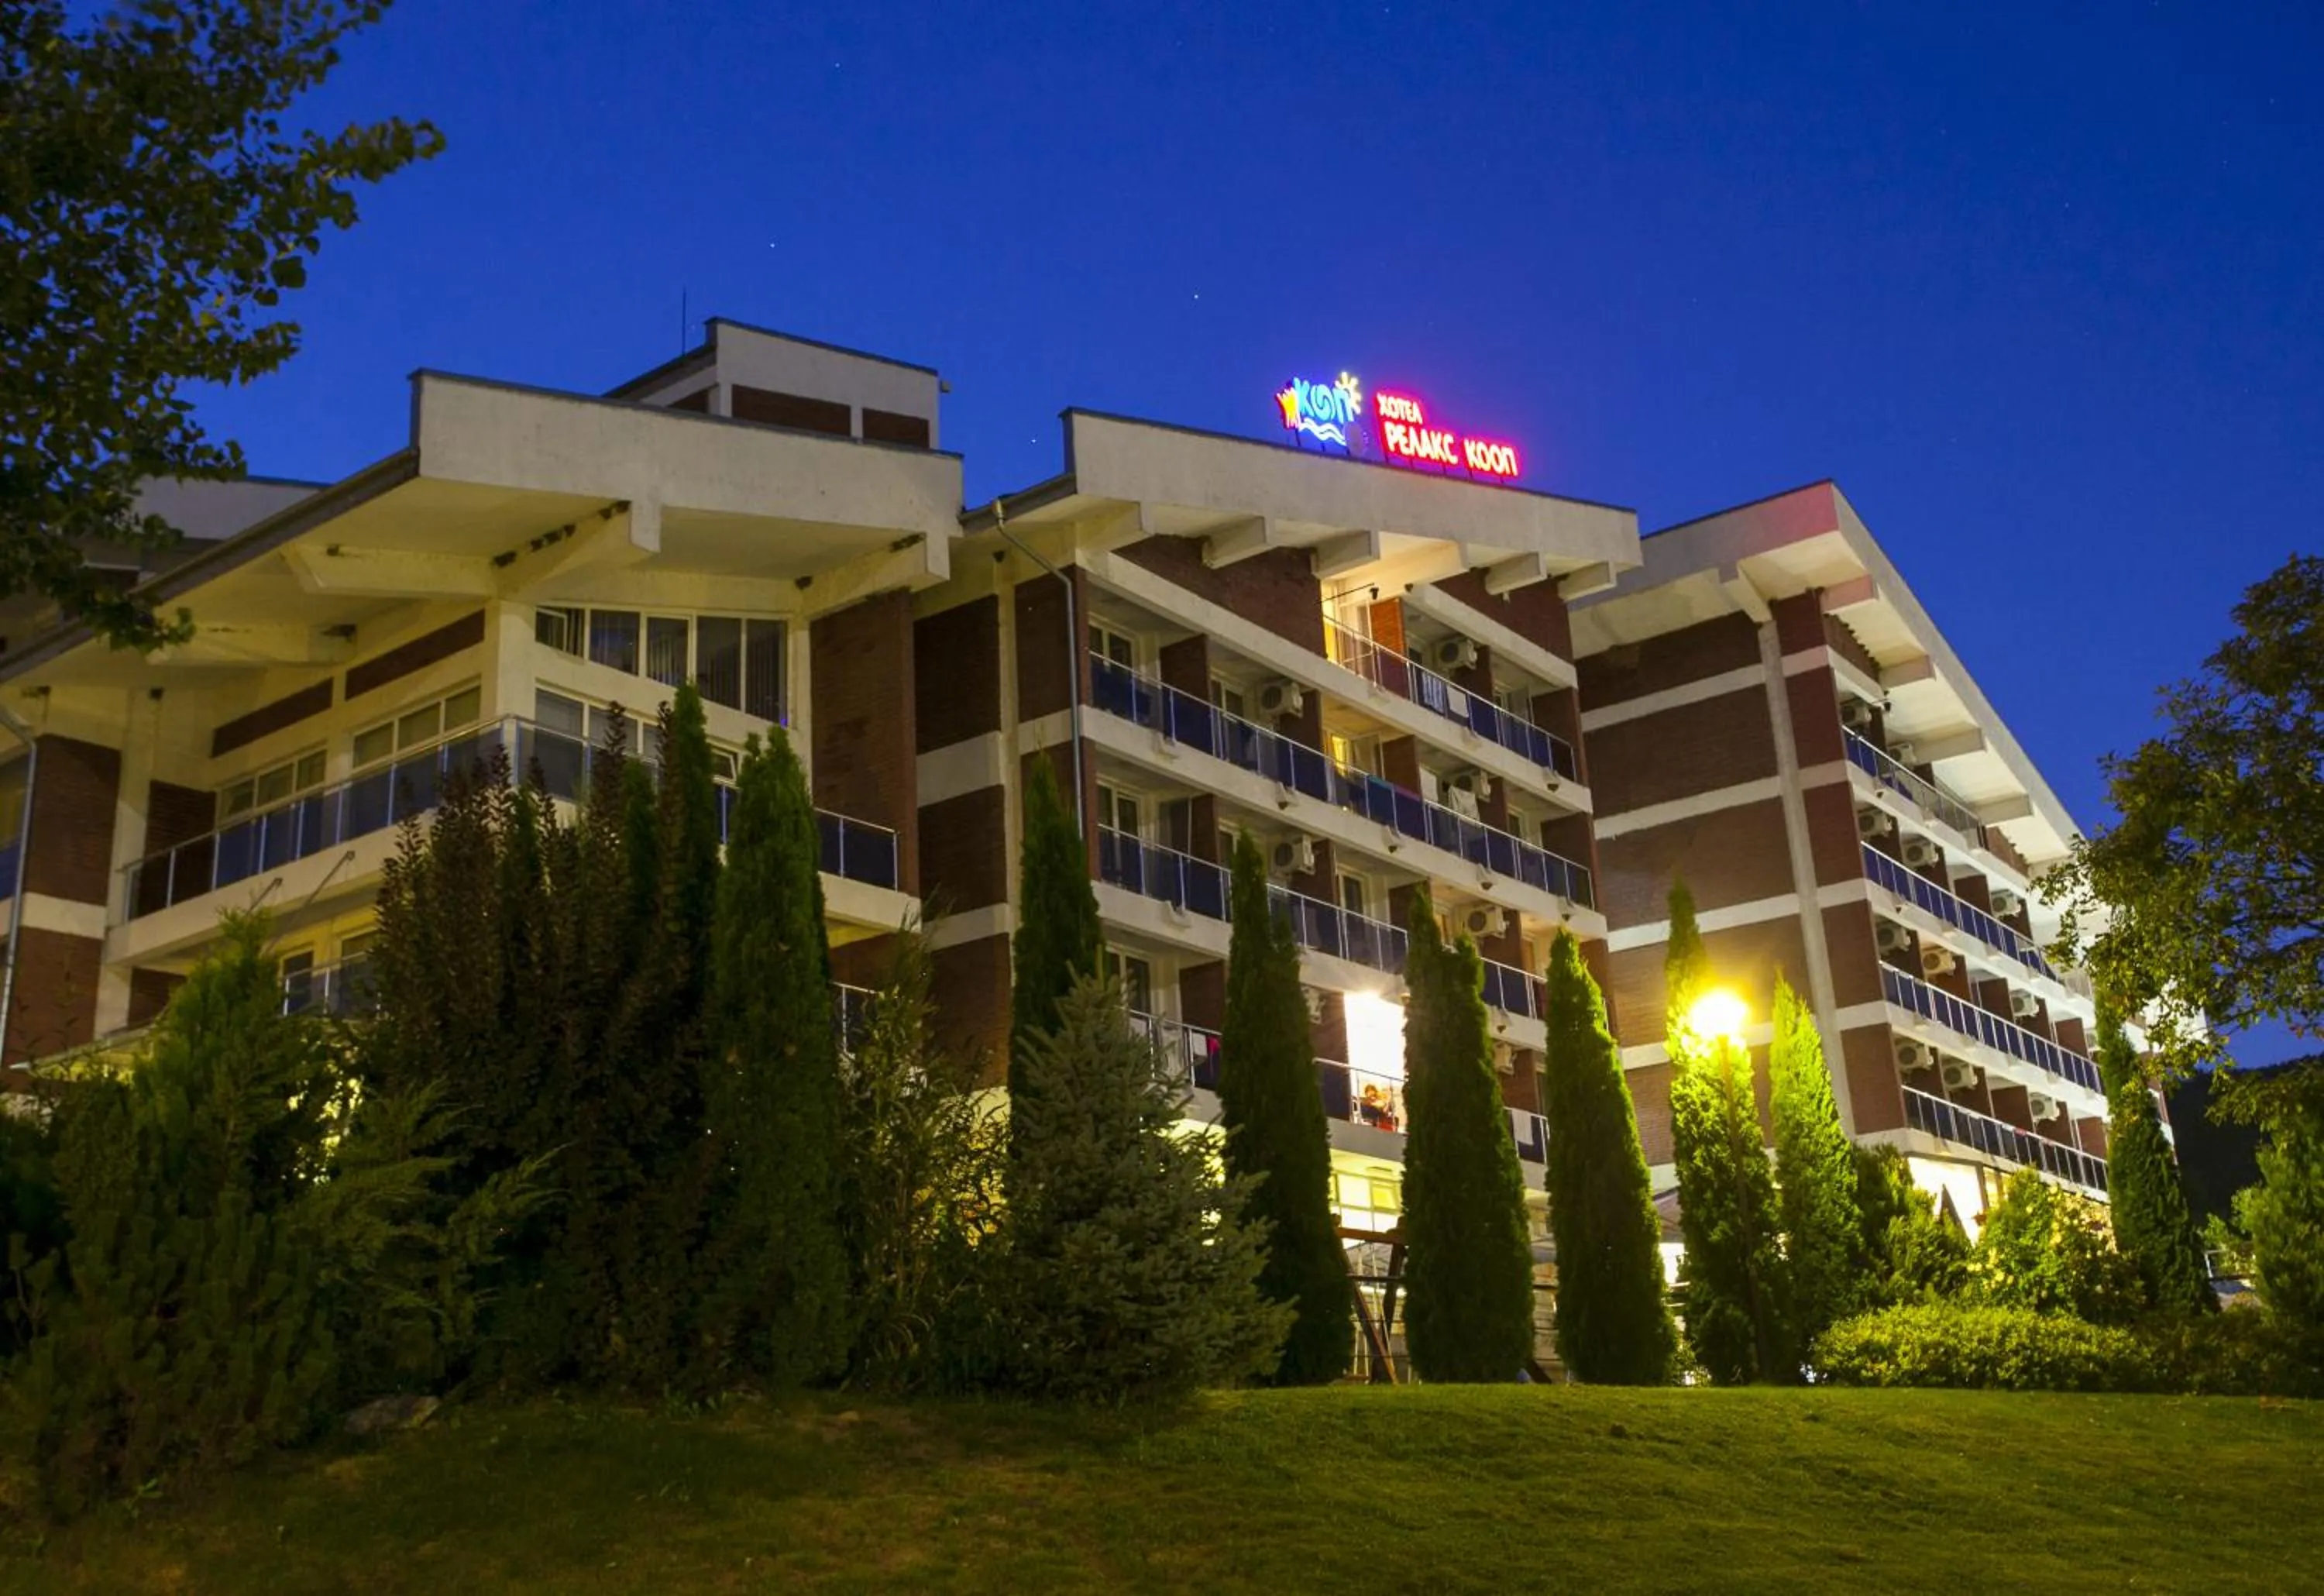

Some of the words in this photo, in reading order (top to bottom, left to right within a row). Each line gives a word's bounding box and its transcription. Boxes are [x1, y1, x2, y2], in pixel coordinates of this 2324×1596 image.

[1377, 392, 1423, 425] ХОТЕЛ
[1384, 421, 1458, 464] РЕЛАКС
[1463, 438, 1518, 476] КООП
